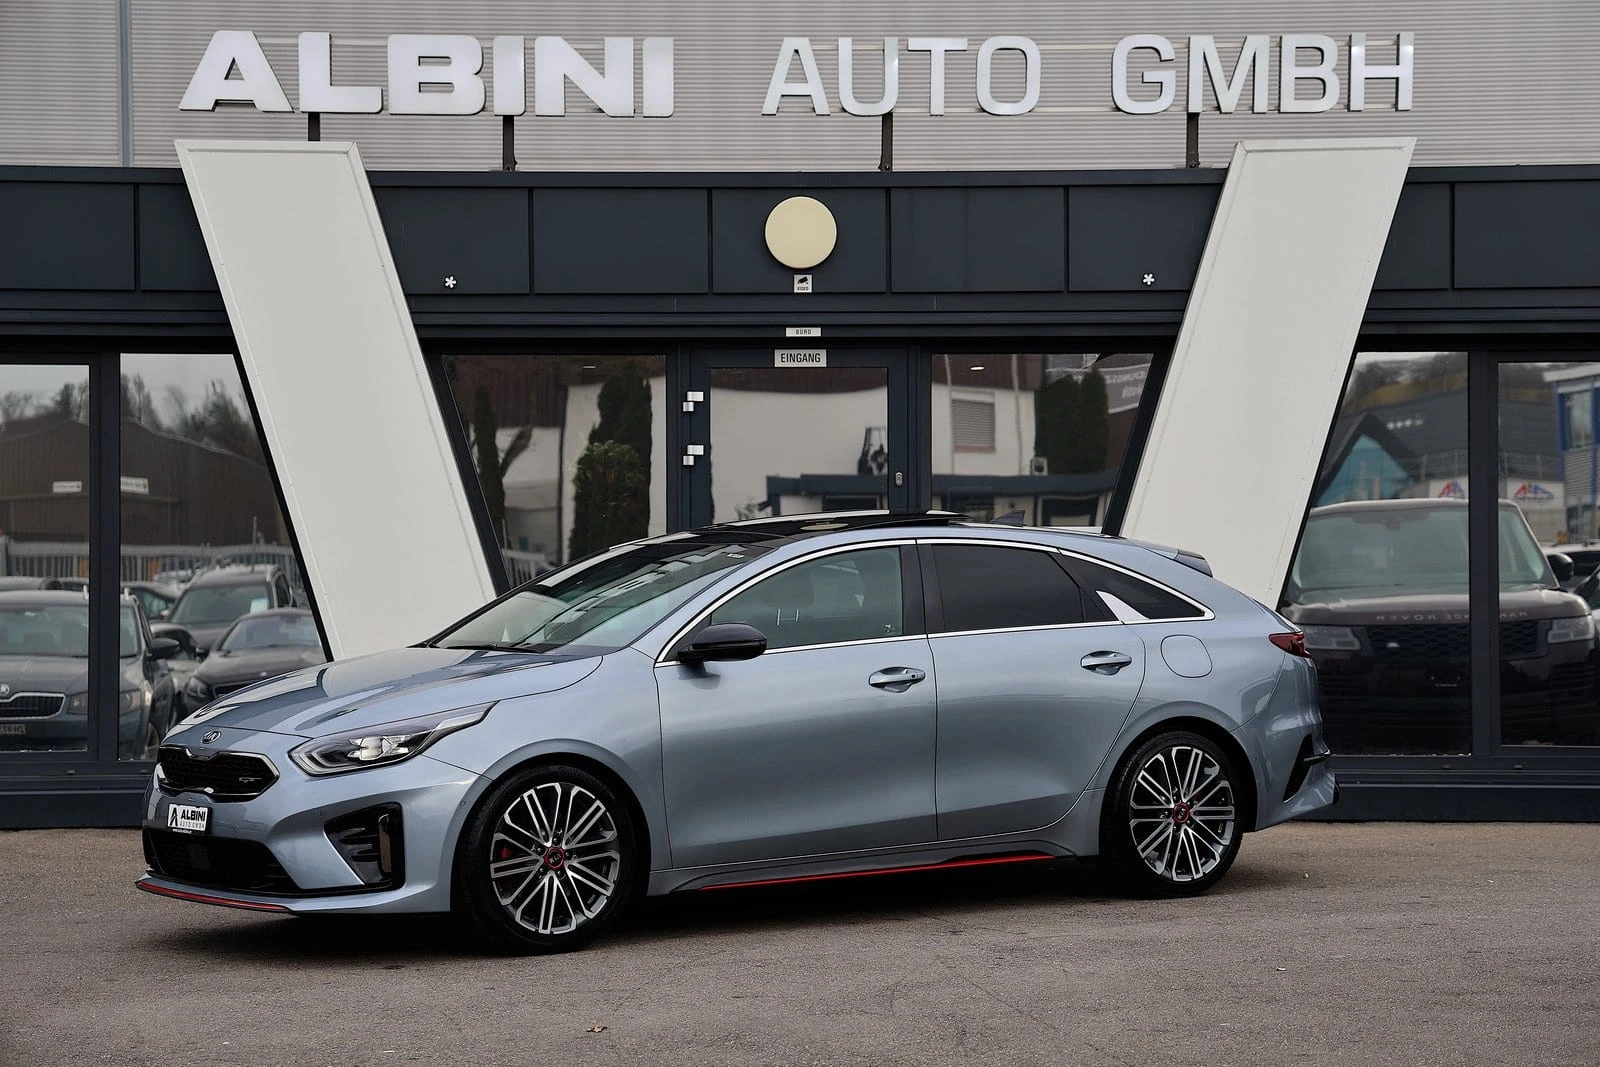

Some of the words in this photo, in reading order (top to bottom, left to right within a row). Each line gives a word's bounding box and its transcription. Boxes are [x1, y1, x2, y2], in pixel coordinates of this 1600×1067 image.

[179, 30, 675, 118] ALBINI
[761, 36, 1042, 117] AUTO
[1111, 32, 1415, 115] GMBH
[780, 352, 821, 363] EINGANG
[180, 808, 206, 822] ALBINI
